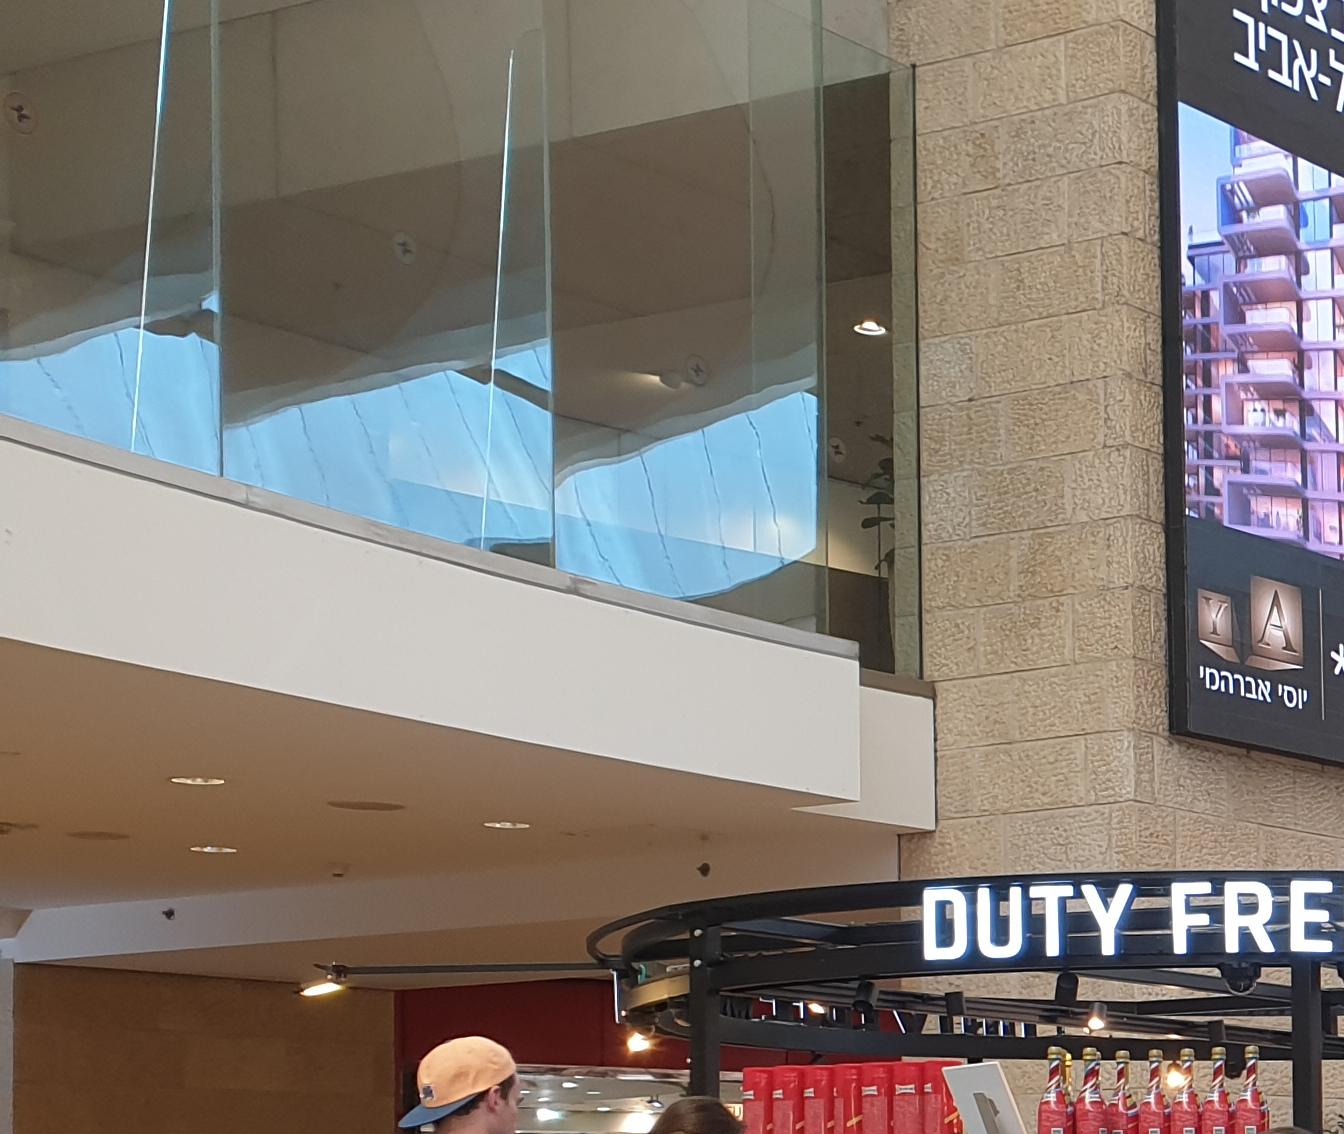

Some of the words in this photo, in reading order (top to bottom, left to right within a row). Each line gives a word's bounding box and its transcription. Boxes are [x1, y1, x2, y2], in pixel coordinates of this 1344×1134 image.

[1199, 666, 1272, 702] אברהמי
[1277, 686, 1308, 710] יוסי
[922, 882, 1135, 962] DUTY
